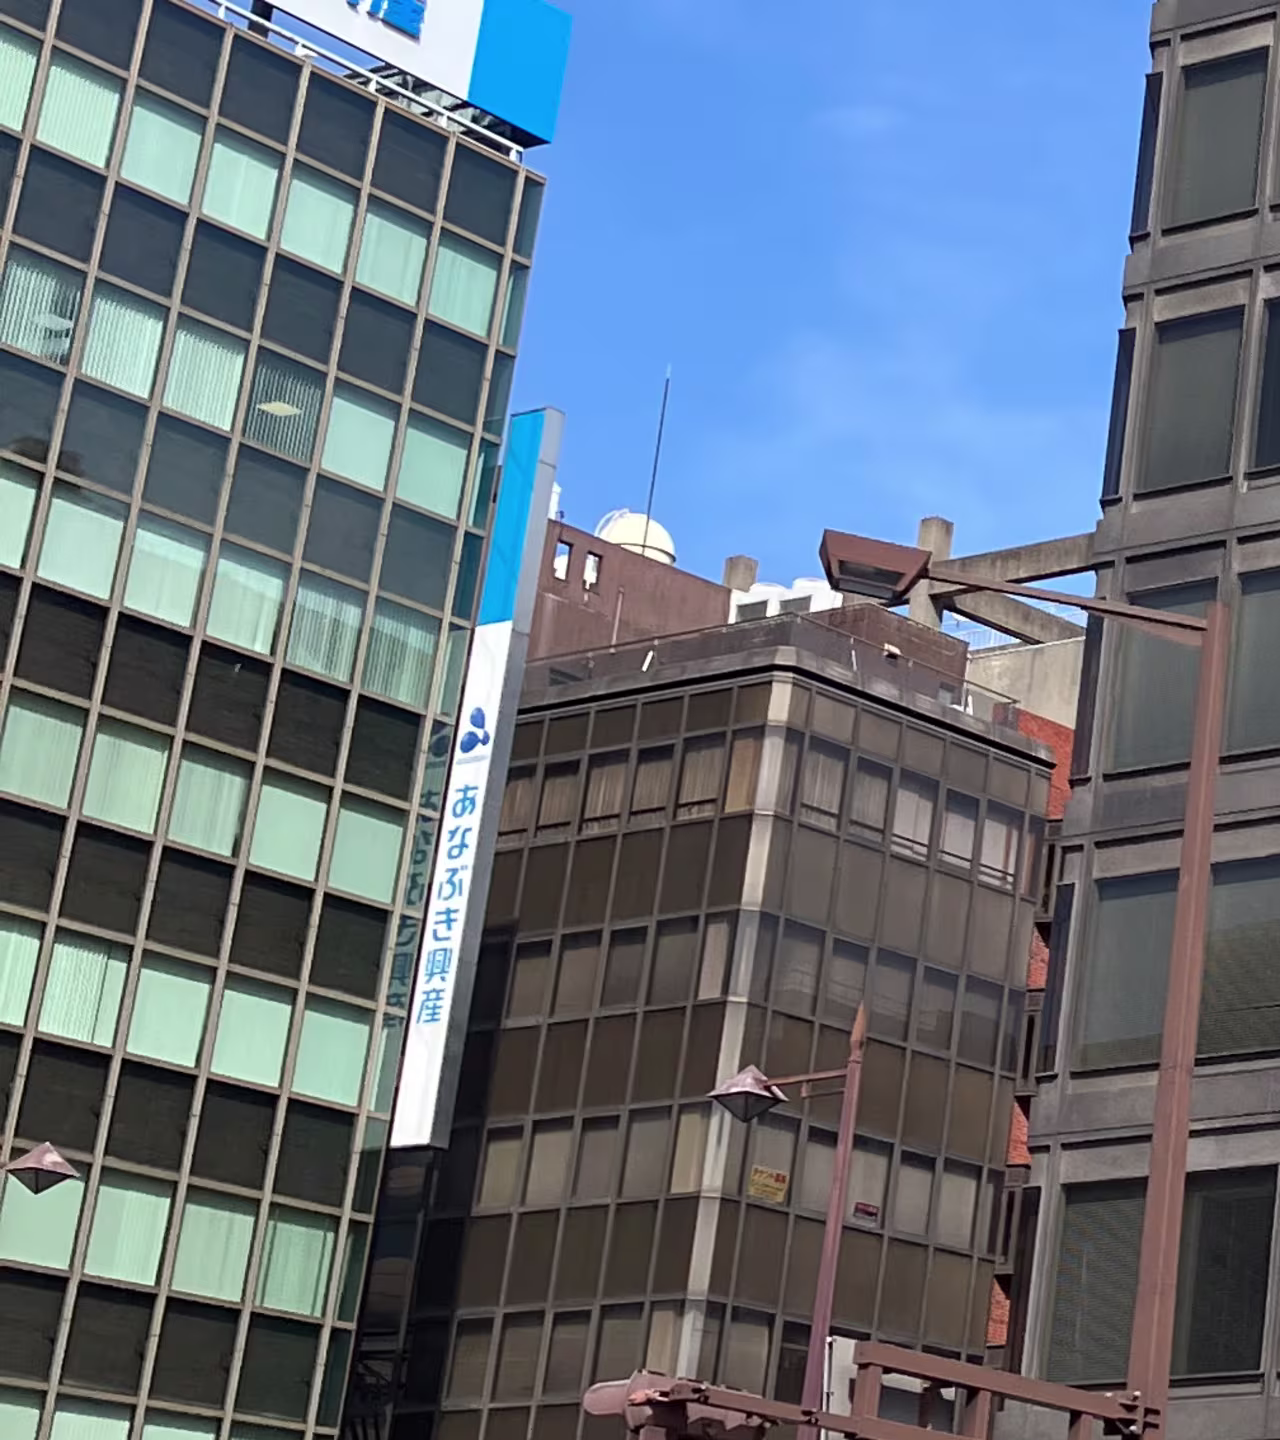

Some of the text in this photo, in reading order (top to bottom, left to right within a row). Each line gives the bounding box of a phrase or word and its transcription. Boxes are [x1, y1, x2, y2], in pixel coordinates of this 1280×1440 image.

[416, 784, 480, 1025] あなぶき興産
